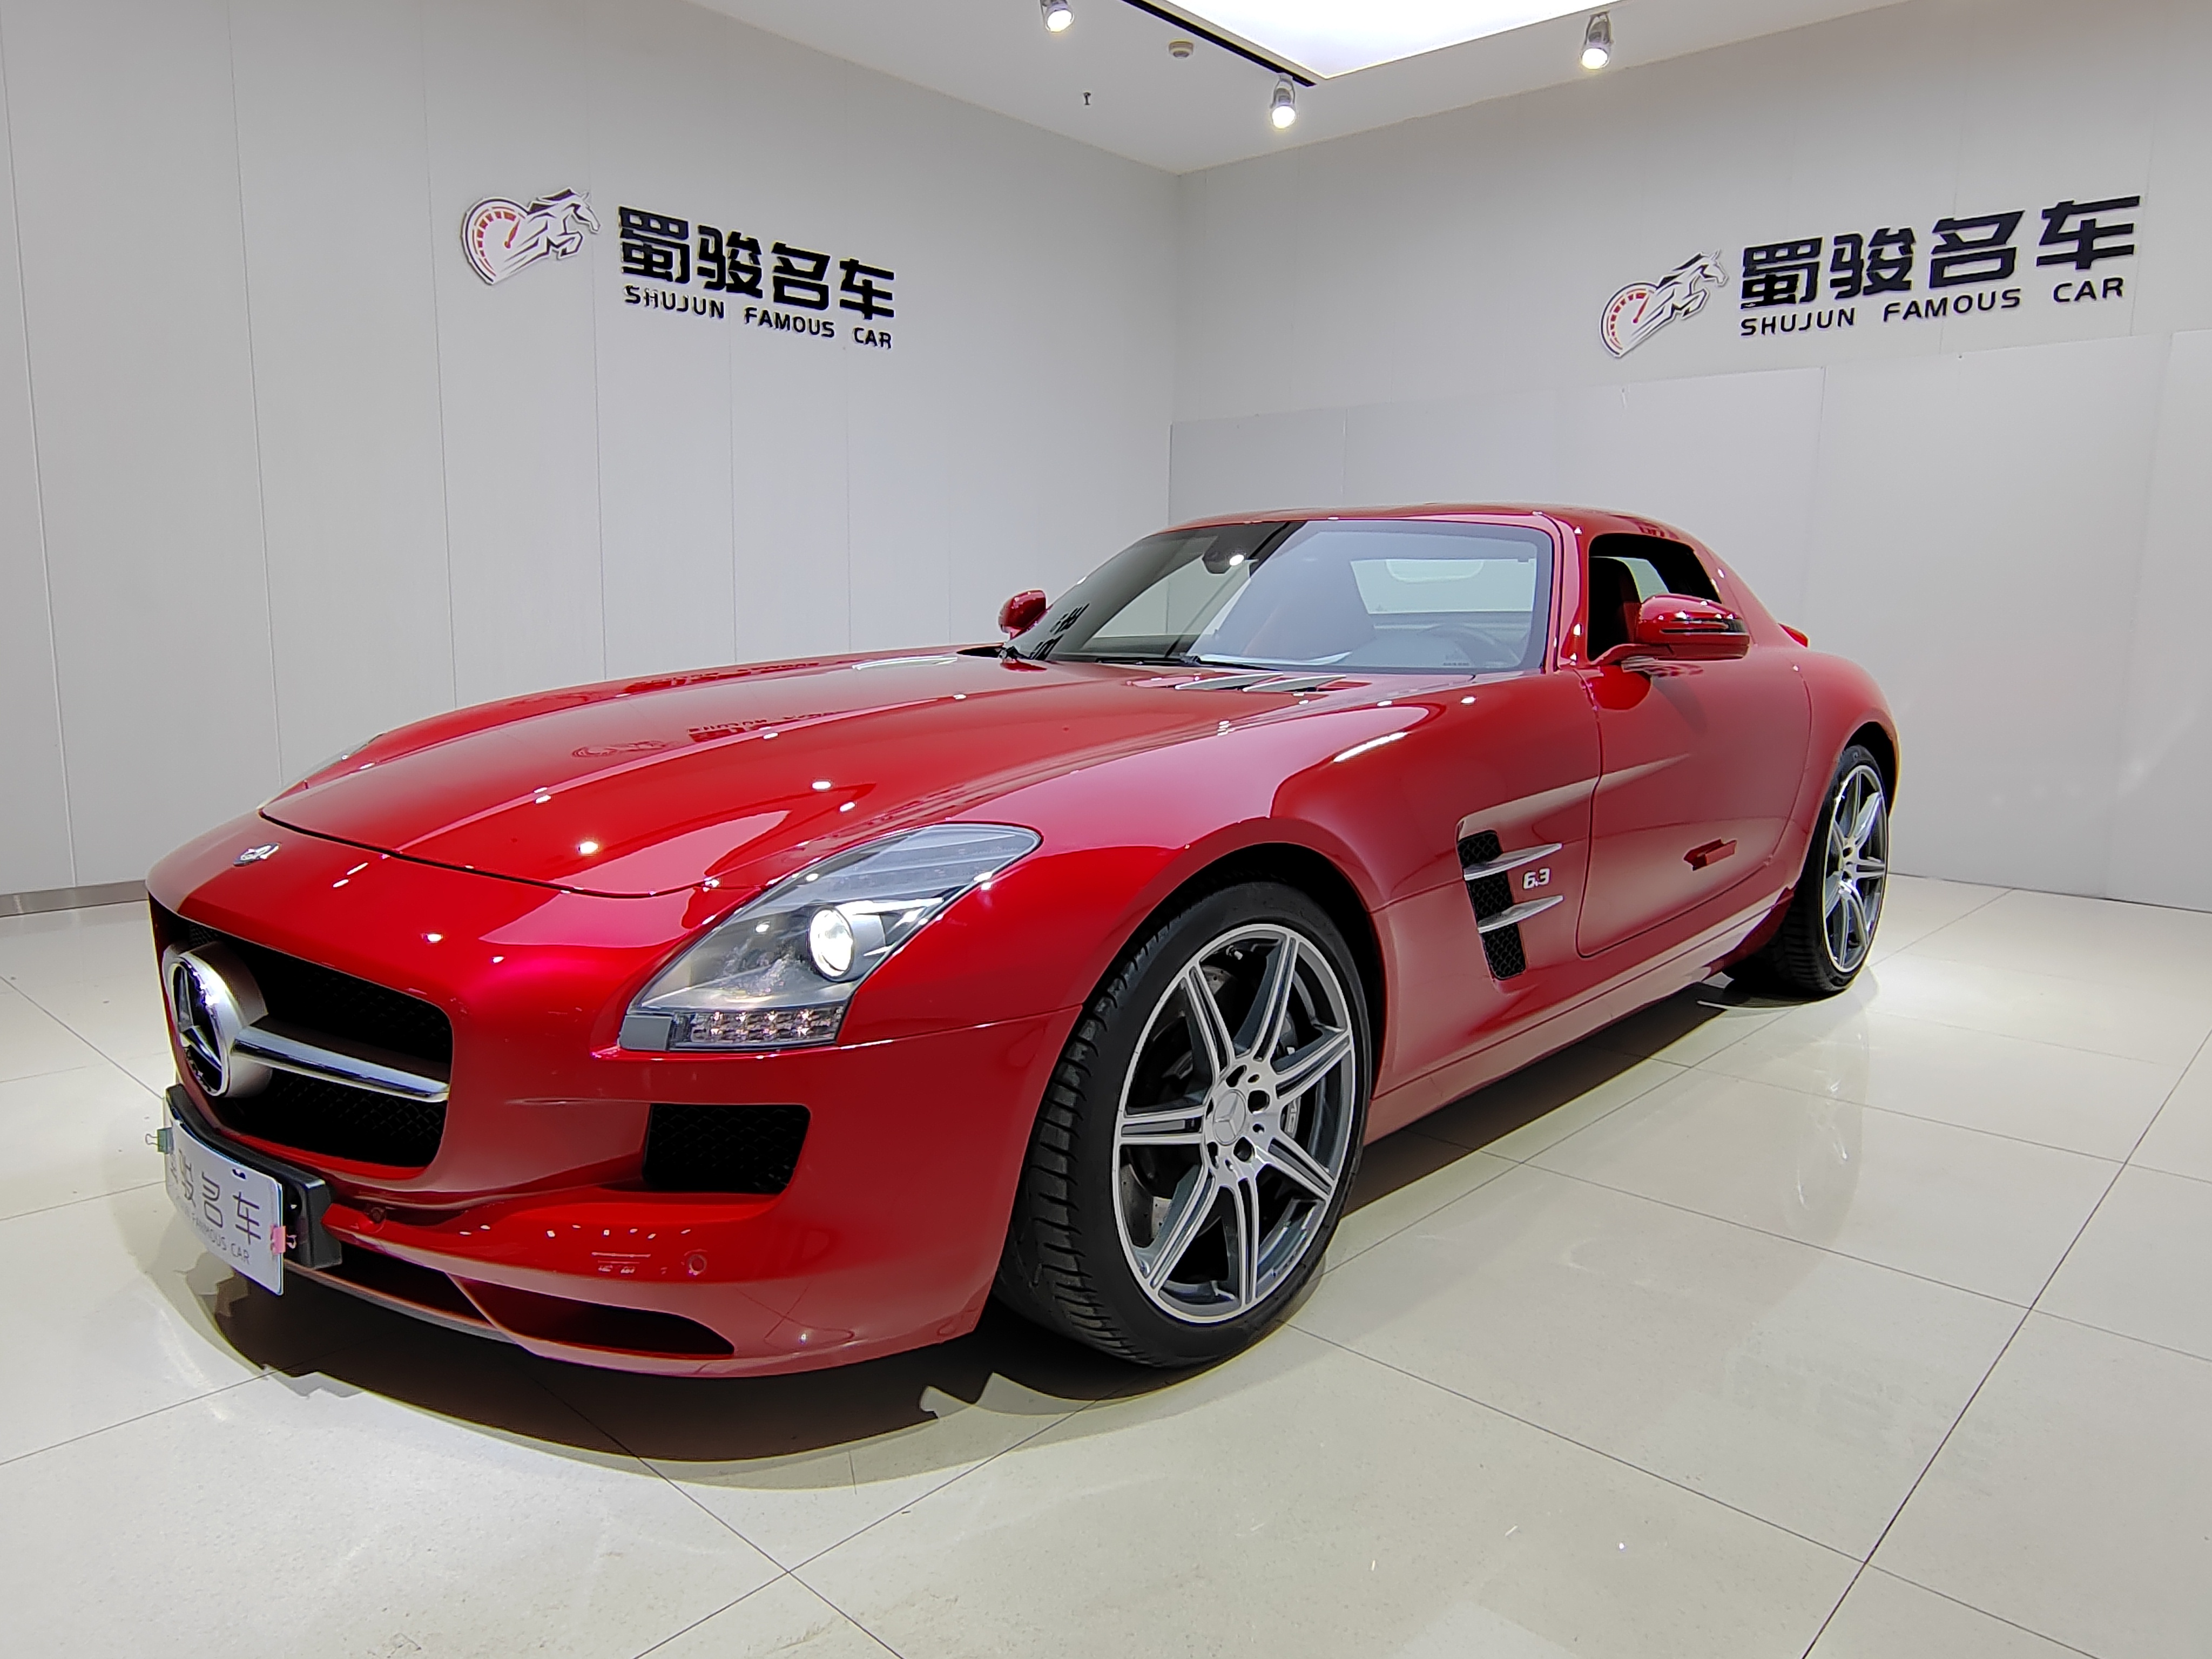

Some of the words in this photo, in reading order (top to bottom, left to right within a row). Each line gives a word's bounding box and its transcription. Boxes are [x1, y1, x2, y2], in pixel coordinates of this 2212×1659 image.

[618, 206, 895, 321] 蜀骏名车
[1740, 195, 2141, 310] 蜀骏名车
[624, 285, 725, 319] SHUJUN
[744, 306, 835, 339] FAMOUS
[854, 327, 892, 349] CAR
[1741, 307, 1856, 336] SHUJUN
[1883, 288, 2021, 323] FAMOUS
[2053, 277, 2124, 304] CAR
[231, 1243, 251, 1265] CAR
